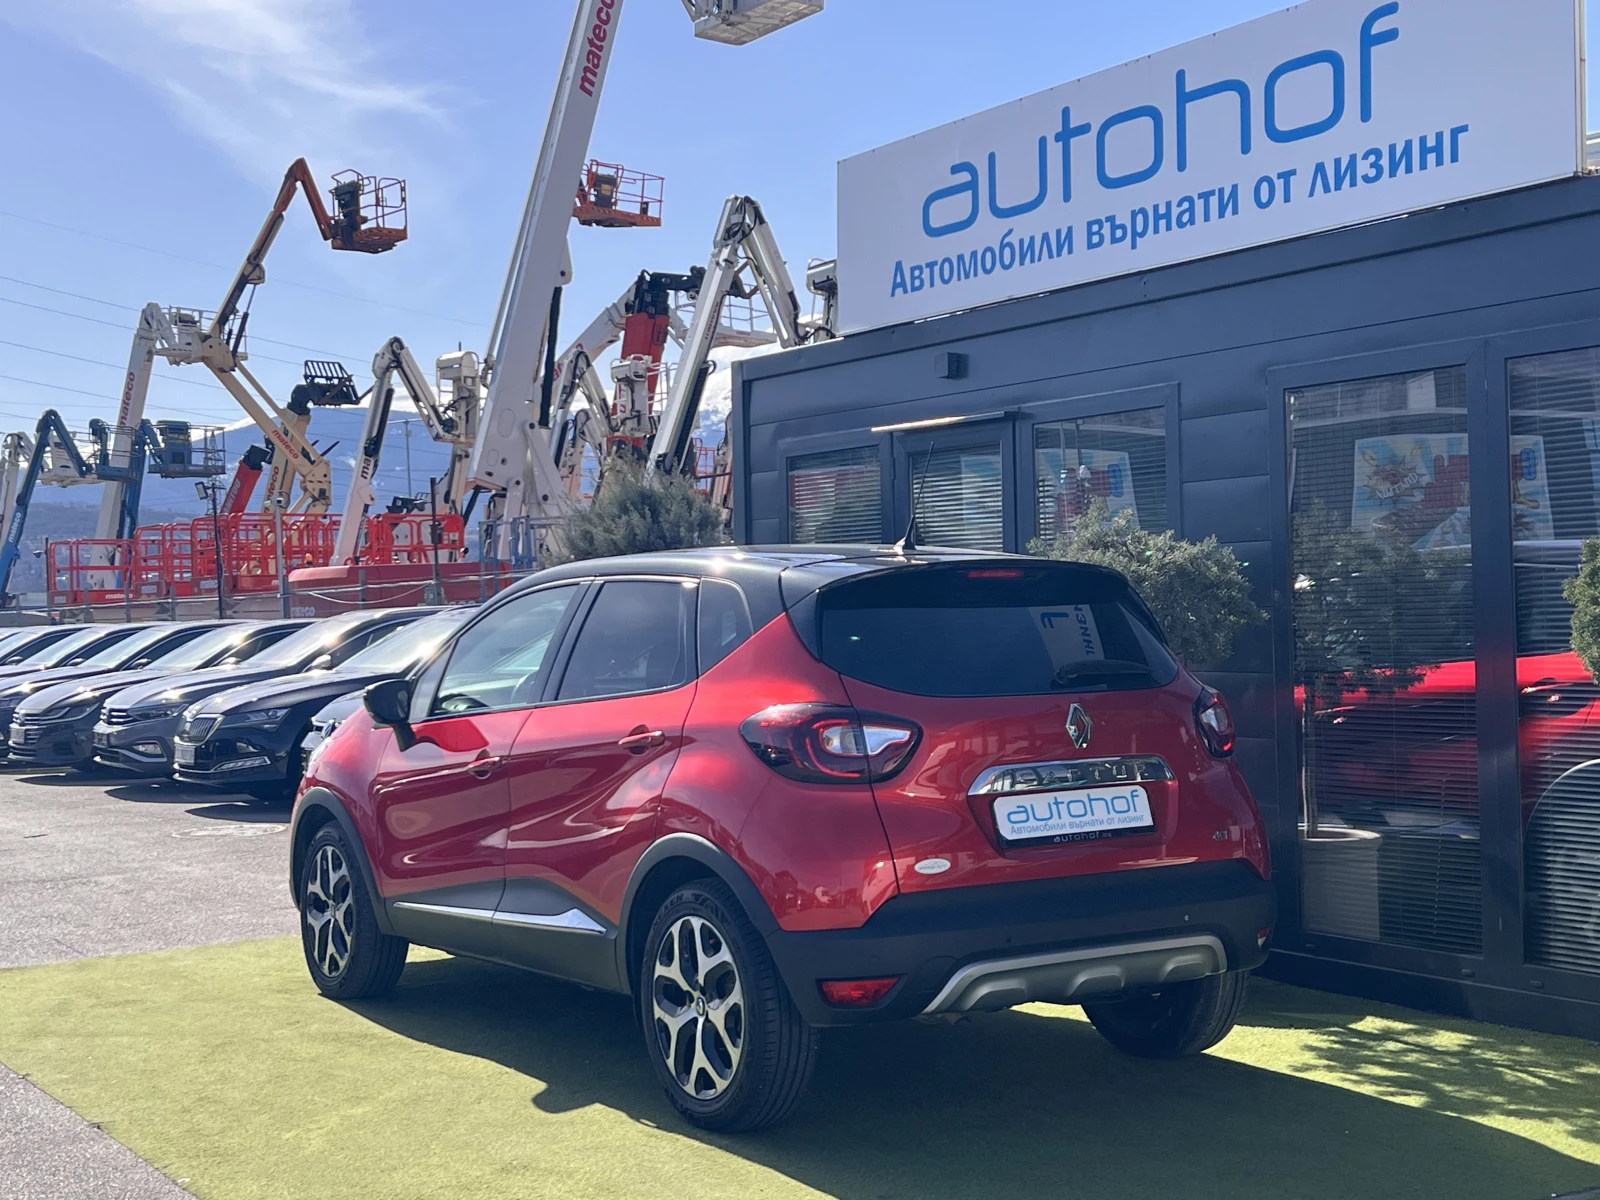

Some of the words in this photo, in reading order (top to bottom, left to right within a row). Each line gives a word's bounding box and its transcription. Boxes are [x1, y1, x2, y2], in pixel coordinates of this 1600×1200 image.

[922, 1, 1400, 238] autohof
[891, 226, 1074, 297] Автомобили
[1086, 184, 1239, 250] върнати
[1254, 169, 1297, 210] от
[1308, 125, 1469, 198] лизинг
[272, 429, 299, 459] mateco
[1006, 789, 1140, 824] autohof
[1010, 820, 1067, 835] Автомобили
[1069, 817, 1105, 831] върнати
[1106, 816, 1115, 825] от
[1117, 814, 1145, 825] лизинг
